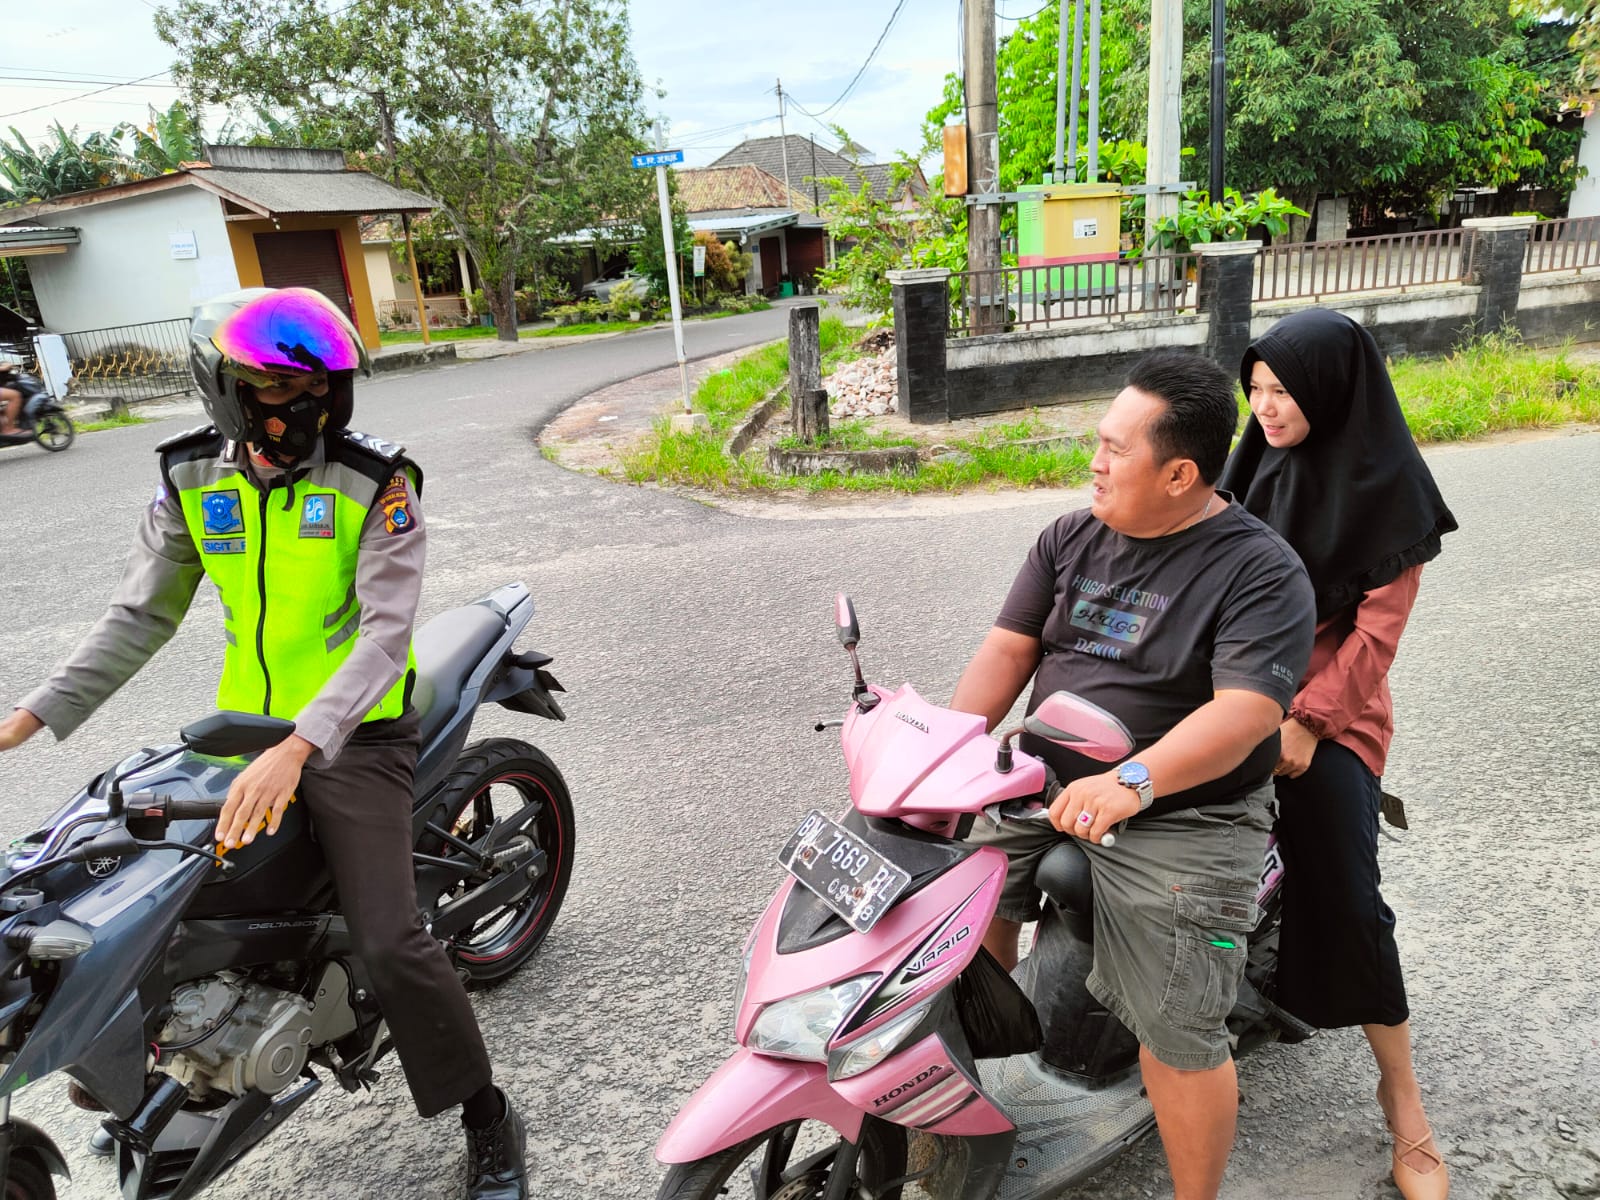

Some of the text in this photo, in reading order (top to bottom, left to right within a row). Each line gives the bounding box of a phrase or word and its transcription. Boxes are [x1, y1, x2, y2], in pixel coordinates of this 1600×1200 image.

[204, 541, 232, 551] SIGIT
[1071, 574, 1106, 596] HUGO
[1073, 637, 1122, 661] DENIM
[895, 711, 929, 734] HONDA
[823, 830, 870, 877] 7669
[247, 920, 320, 930] DELTABOX
[905, 926, 970, 972] VARIO
[872, 1064, 943, 1107] HONDA
